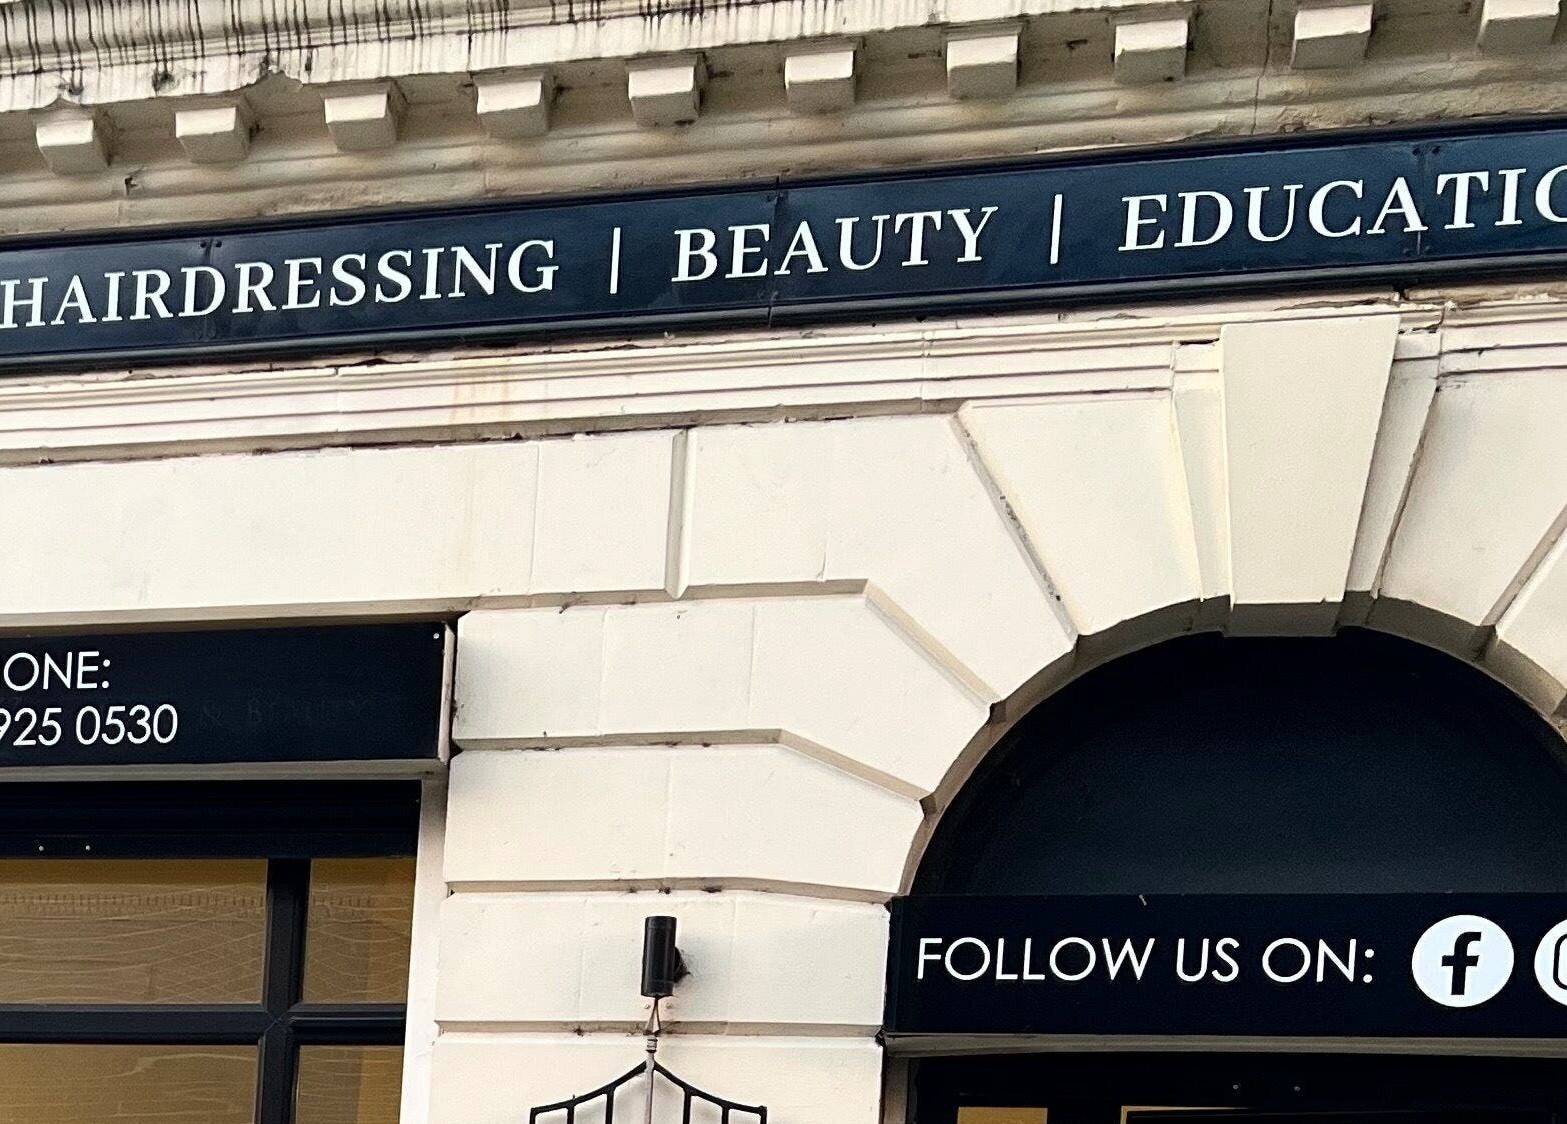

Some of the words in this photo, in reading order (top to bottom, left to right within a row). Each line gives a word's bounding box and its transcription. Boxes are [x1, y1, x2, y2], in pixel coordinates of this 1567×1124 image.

[671, 206, 998, 283] BEAUTY
[75, 703, 179, 746] 0530
[917, 937, 1155, 981] FOLLOW
[1176, 937, 1240, 982] US
[1262, 937, 1375, 983] ON:
